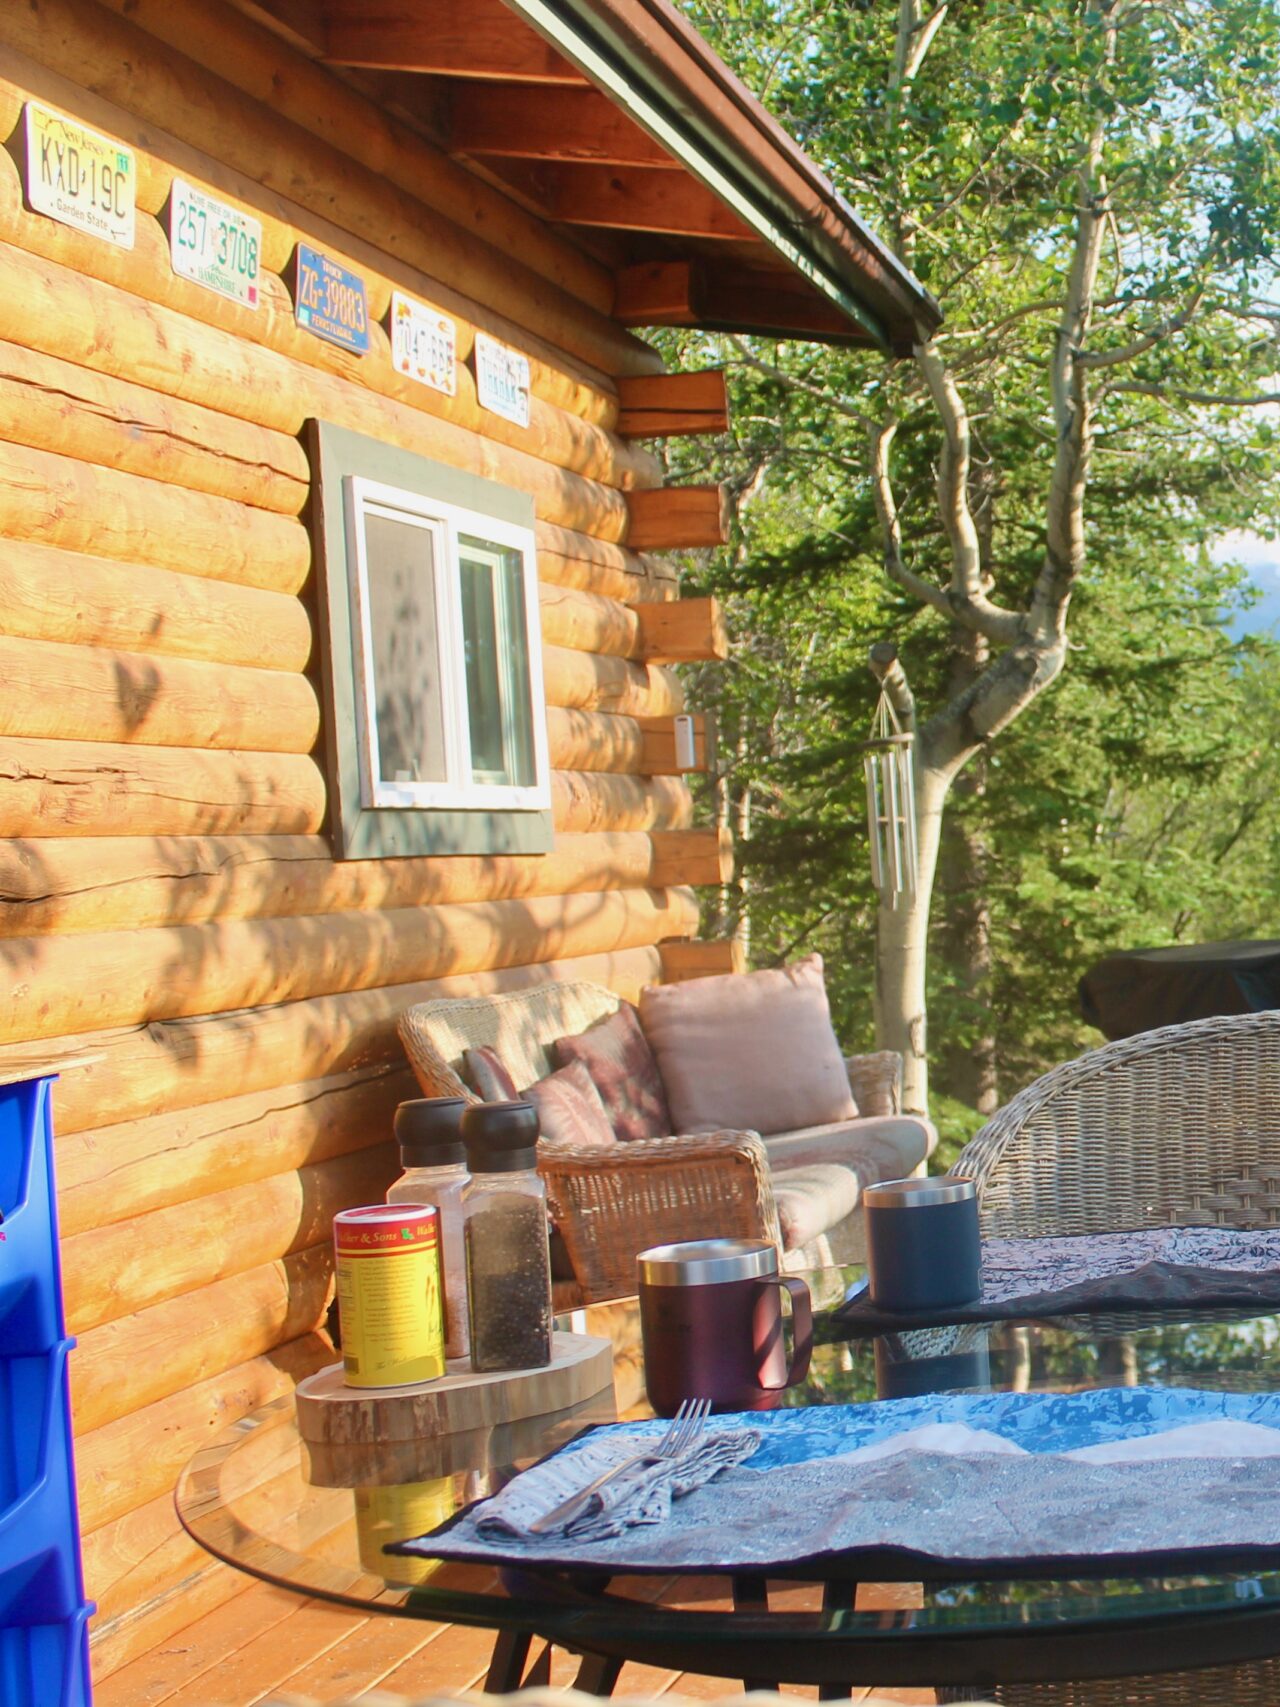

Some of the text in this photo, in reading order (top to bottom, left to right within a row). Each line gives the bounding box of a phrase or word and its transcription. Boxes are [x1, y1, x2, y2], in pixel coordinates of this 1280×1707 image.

[56, 197, 109, 230] Garden State
[360, 1233, 372, 1244] &
[373, 1232, 398, 1242] Sons
